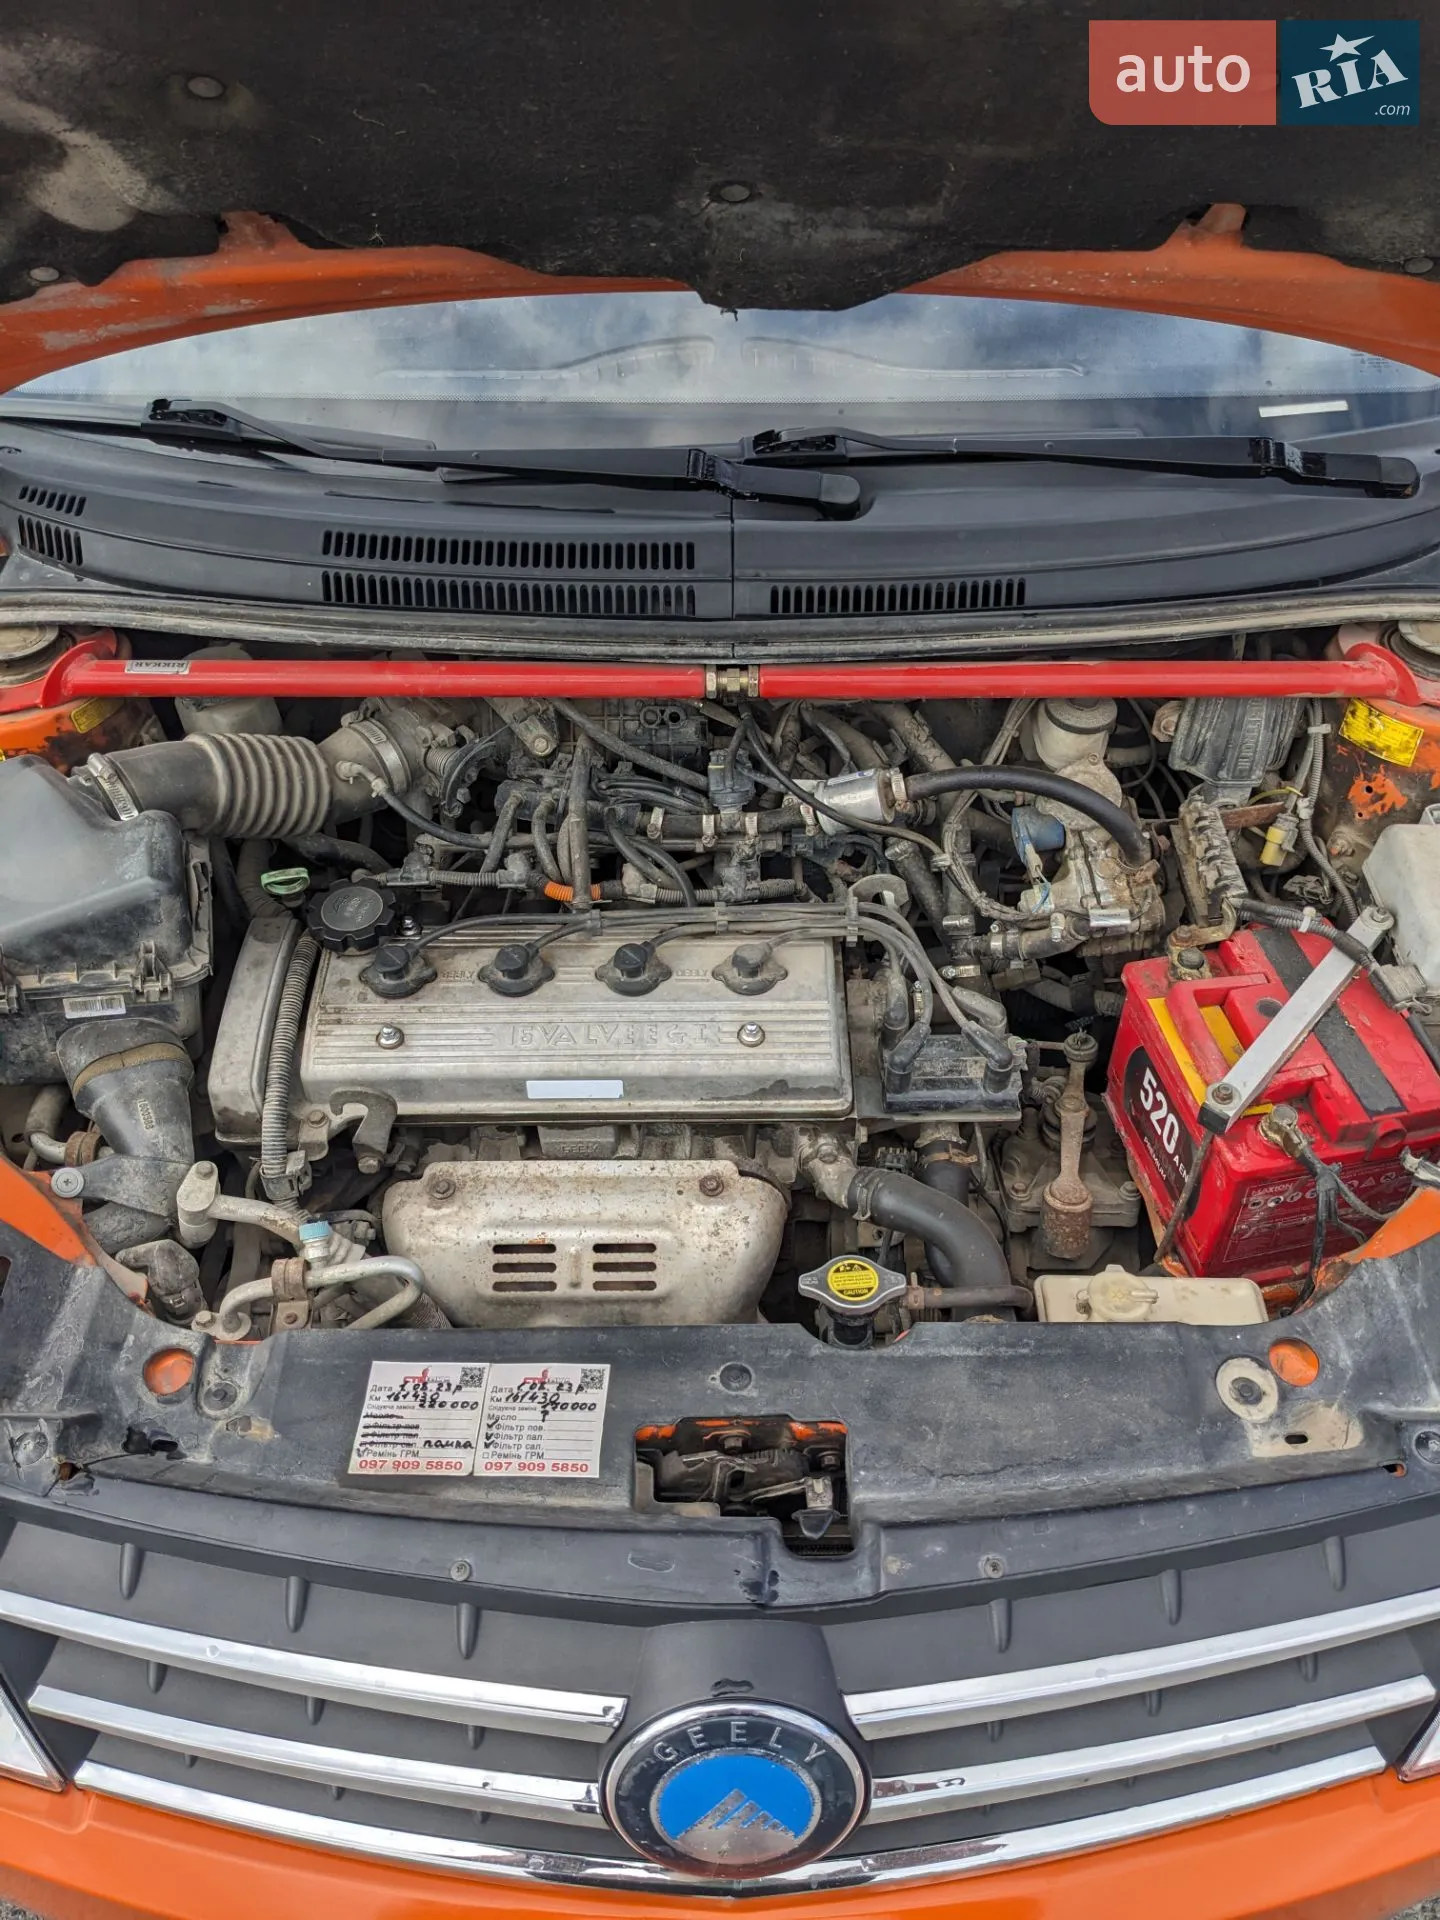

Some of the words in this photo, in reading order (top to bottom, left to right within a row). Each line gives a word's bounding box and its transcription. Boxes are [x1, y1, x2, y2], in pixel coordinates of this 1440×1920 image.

[1140, 1067, 1180, 1154] 520
[490, 1385, 514, 1393] Дата
[487, 1413, 517, 1421] Масло
[495, 1423, 524, 1431] Фільтр
[493, 1432, 523, 1440] Фільтр
[492, 1441, 522, 1450] Фільтр
[367, 1450, 397, 1458] Ремінь
[491, 1451, 521, 1459] Ремінь
[359, 1460, 387, 1469] 097
[392, 1460, 420, 1470] 909
[425, 1461, 463, 1470] 5850
[484, 1461, 513, 1471] 097
[518, 1462, 546, 1471] 909
[551, 1463, 588, 1472] 5850
[653, 1721, 826, 1763] GEELY
